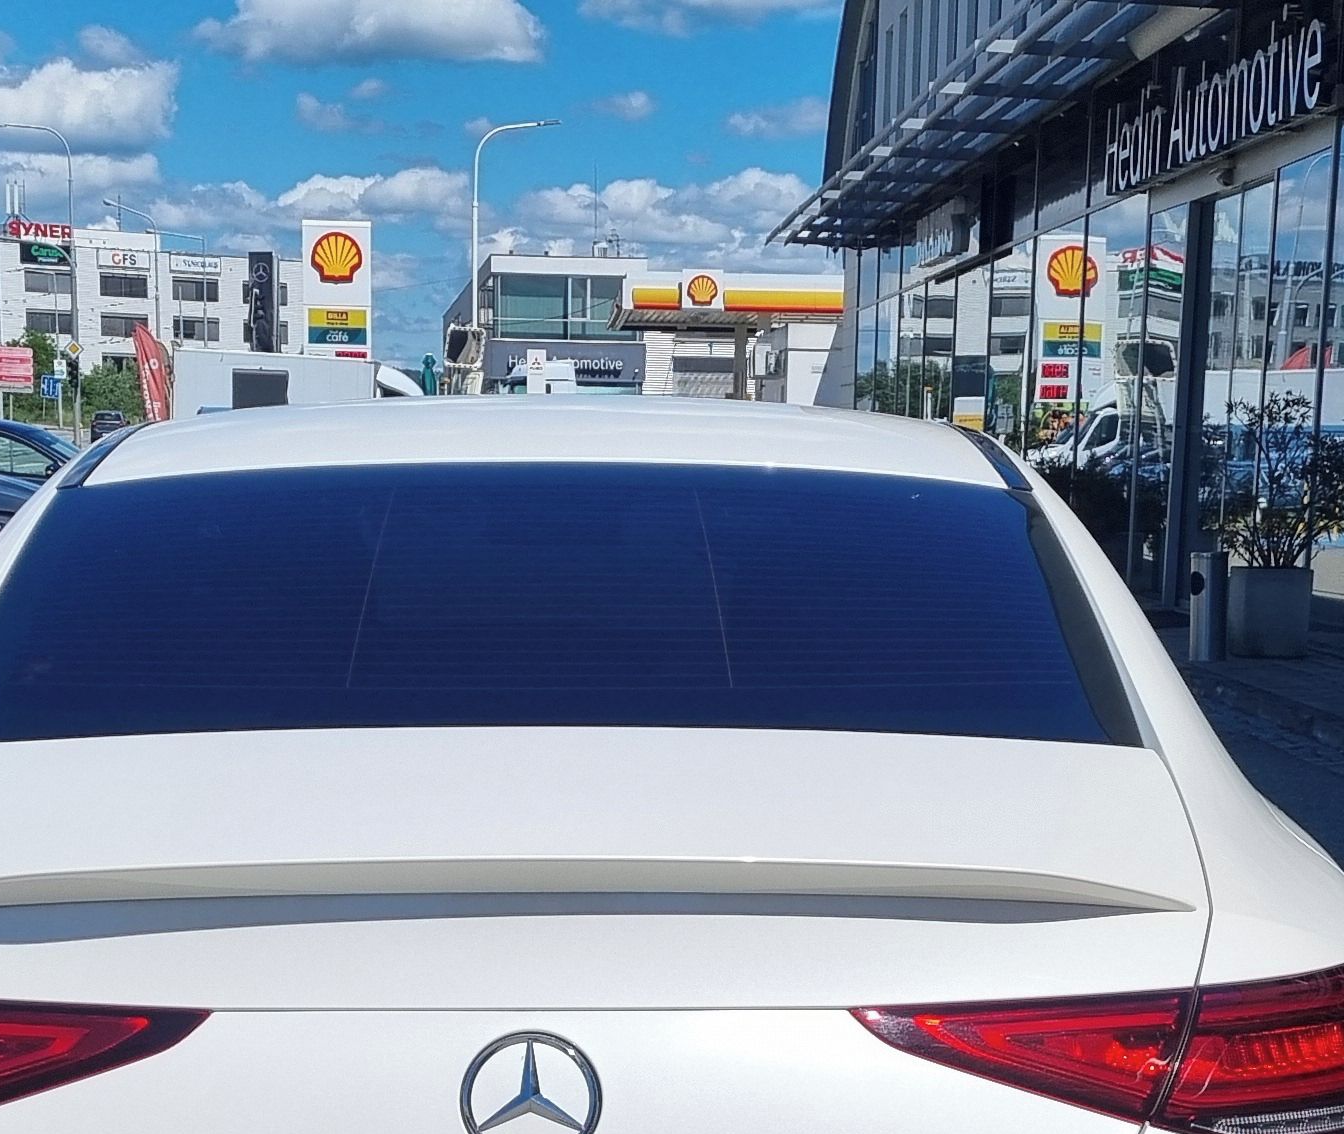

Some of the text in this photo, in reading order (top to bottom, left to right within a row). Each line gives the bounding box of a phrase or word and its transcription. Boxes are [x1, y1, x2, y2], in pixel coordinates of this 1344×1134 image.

[1106, 3, 1322, 194] Hedin Automotive
[8, 220, 72, 239] SYNER
